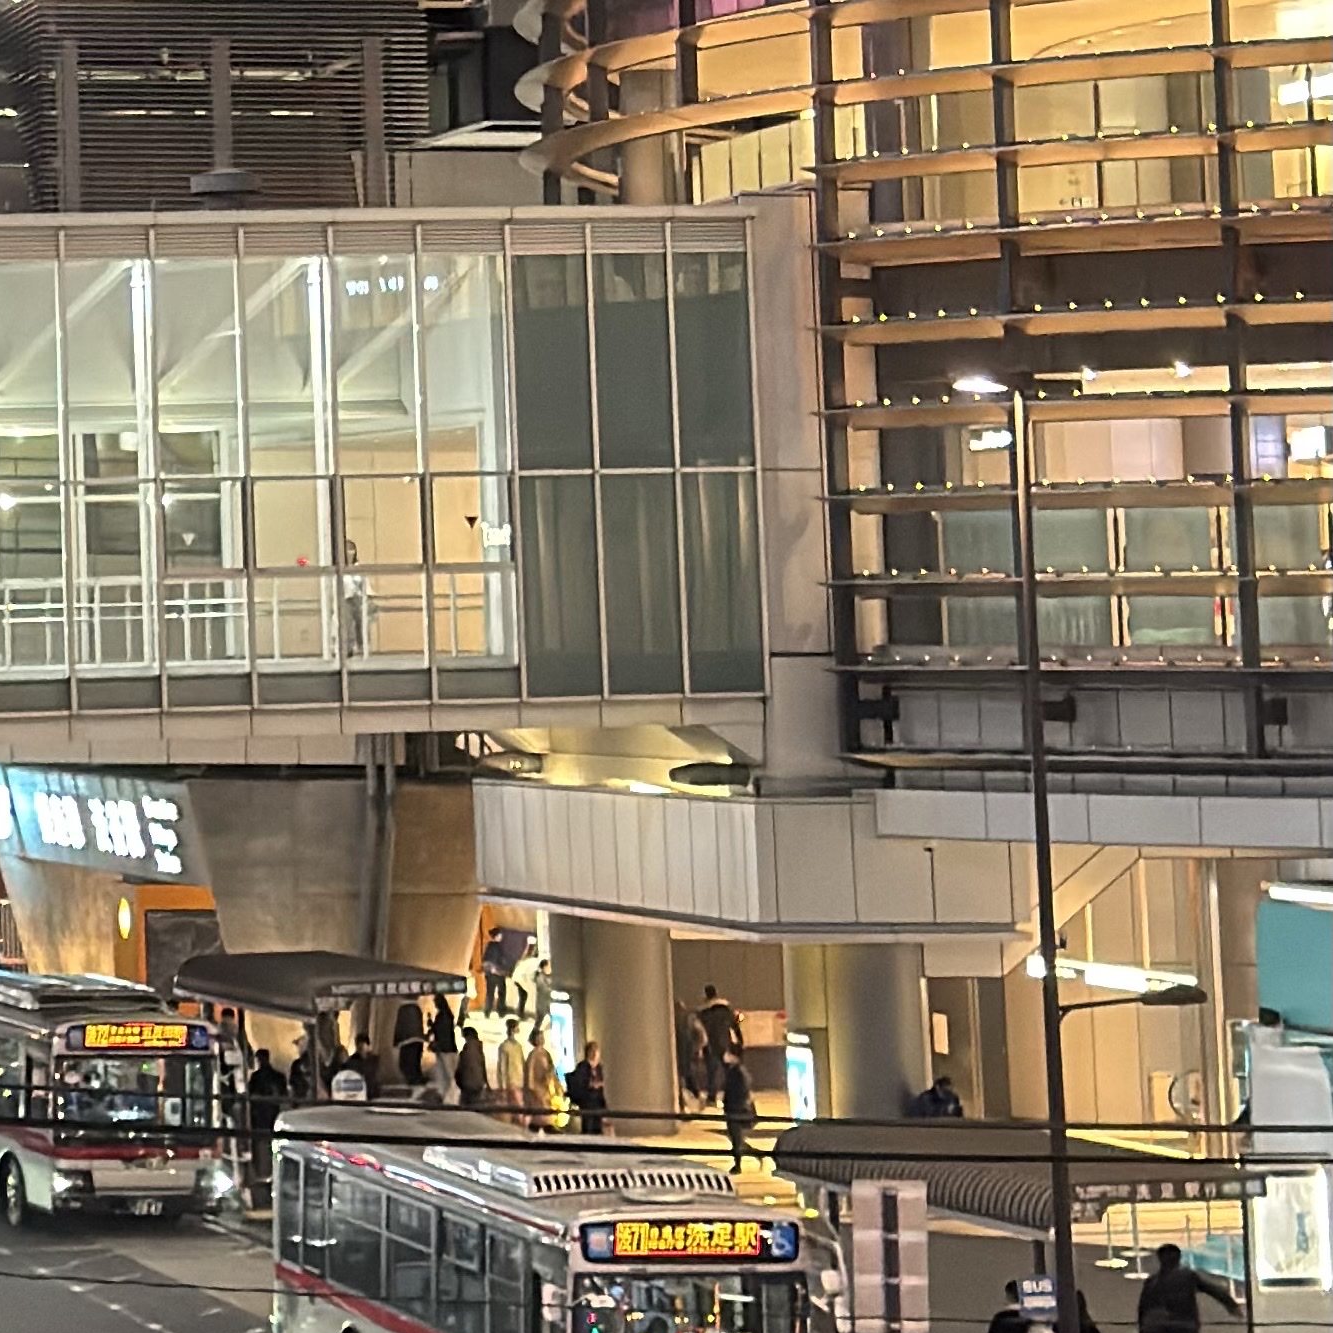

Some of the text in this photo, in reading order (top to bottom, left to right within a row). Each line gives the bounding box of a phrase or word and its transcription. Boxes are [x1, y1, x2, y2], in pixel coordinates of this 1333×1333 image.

[686, 1223, 757, 1246] 洗足駅
[1023, 1279, 1053, 1294] BUS
